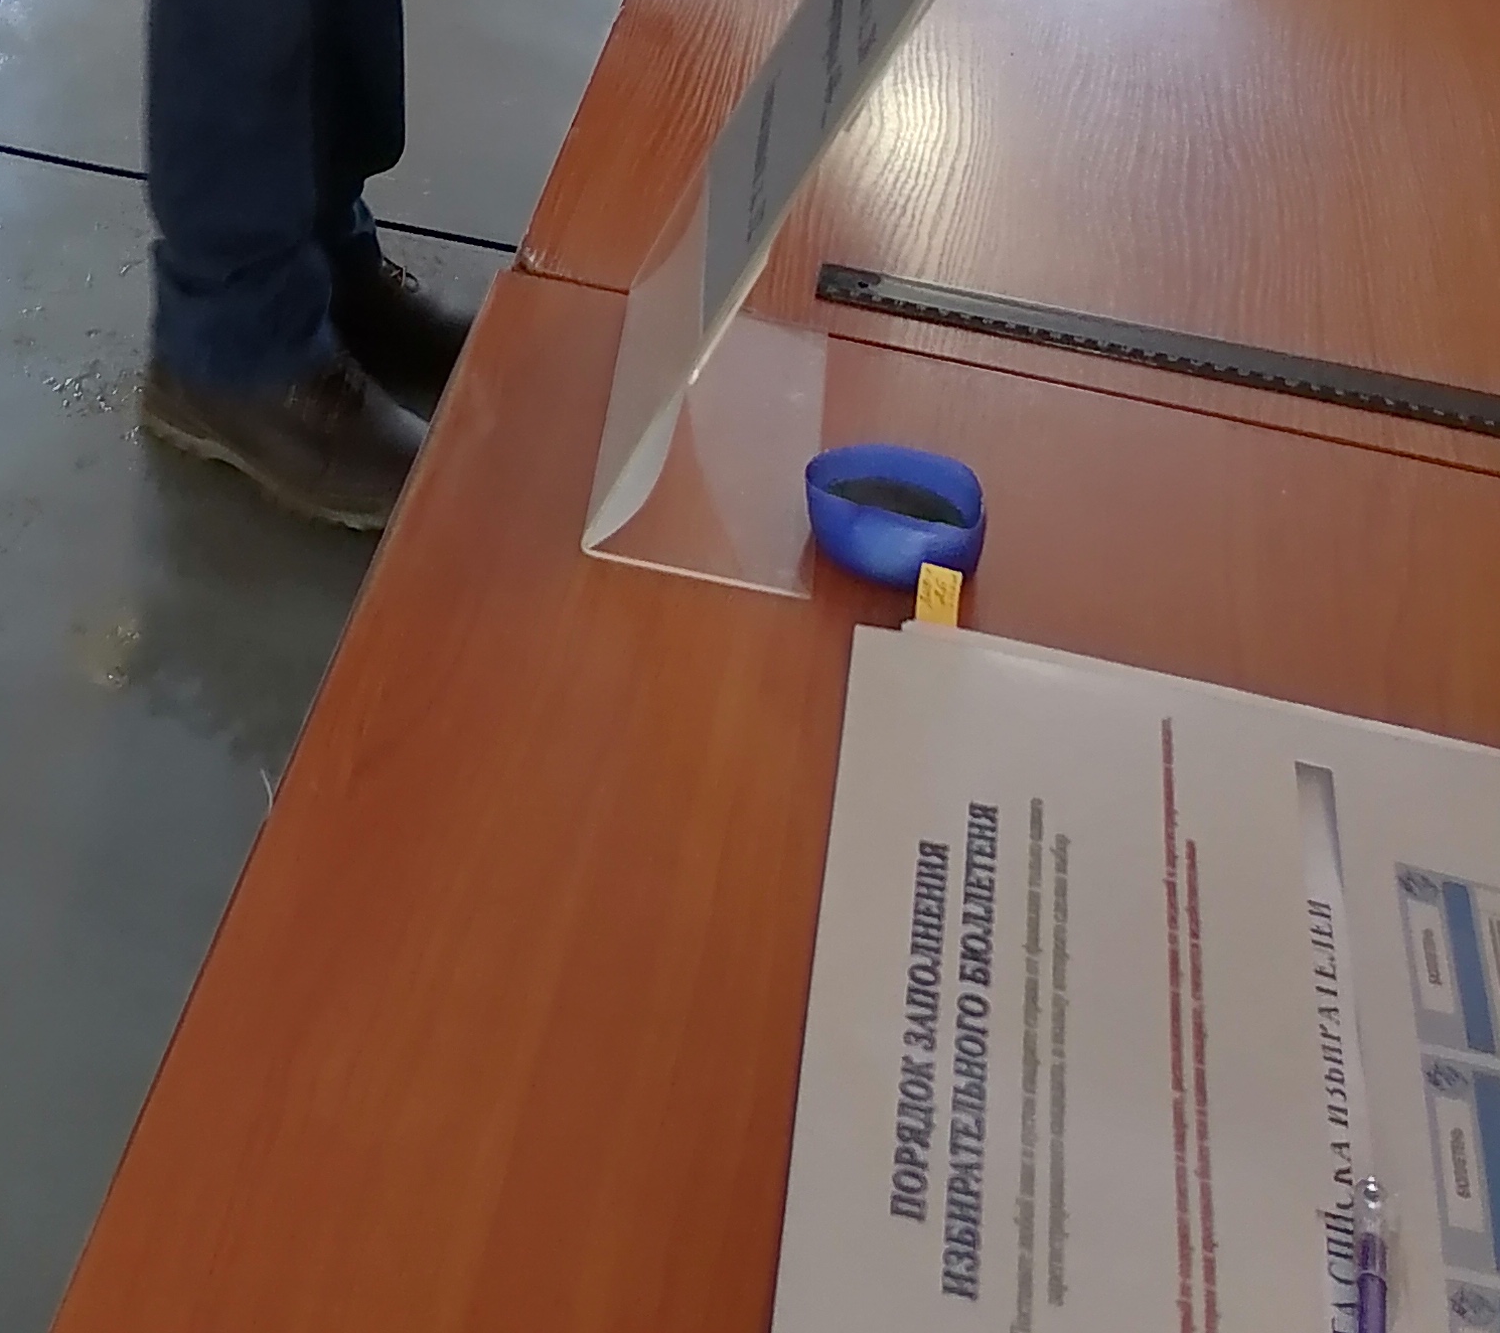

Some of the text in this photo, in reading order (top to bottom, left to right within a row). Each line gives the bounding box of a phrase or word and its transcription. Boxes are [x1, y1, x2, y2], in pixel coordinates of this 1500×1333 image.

[890, 840, 950, 1223] ПОРЯДОК ЗАПОЛНЕНИЯ
[941, 800, 999, 1301] ИЗБИРАТЕЛЬНОГО БЮЛЛЕТЕНЯ
